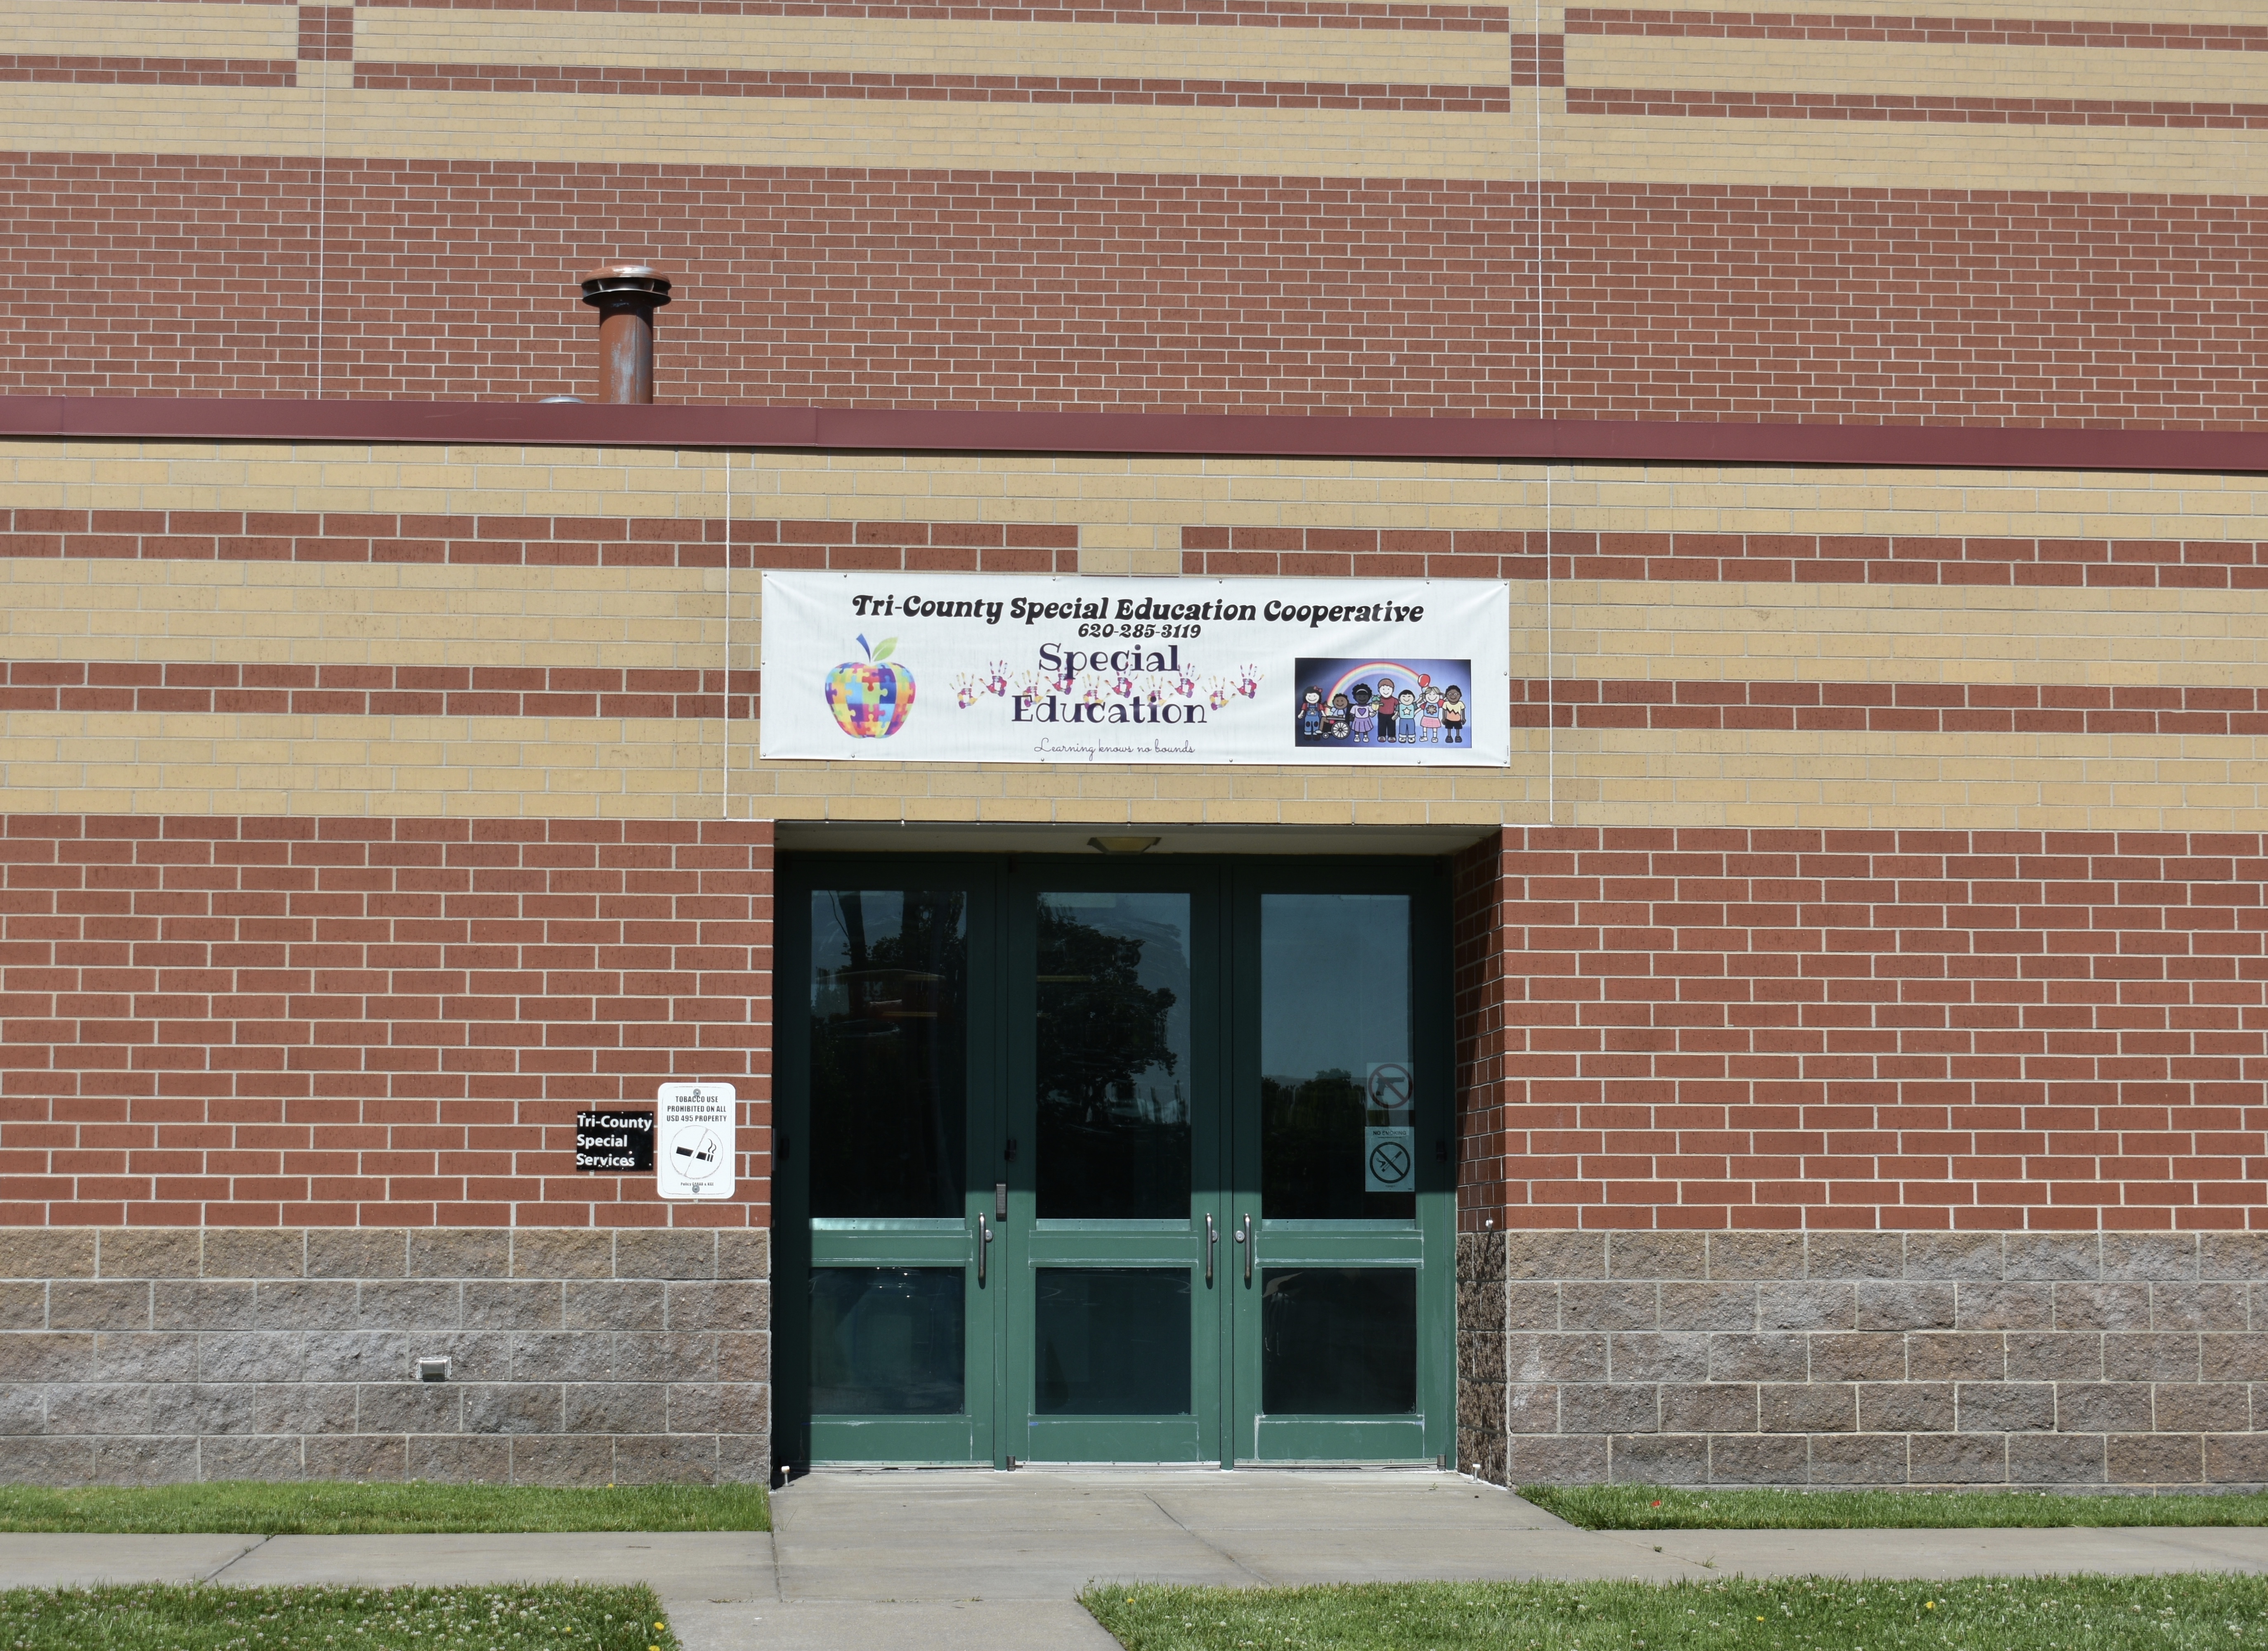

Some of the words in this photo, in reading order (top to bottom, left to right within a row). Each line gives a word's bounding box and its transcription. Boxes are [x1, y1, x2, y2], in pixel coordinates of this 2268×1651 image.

[852, 594, 1003, 624] Tri-County
[1010, 597, 1109, 625] Special
[1115, 597, 1256, 621] Education
[1263, 600, 1424, 628] Cooperative
[1078, 623, 1201, 639] 620-285-3119
[1038, 643, 1180, 680] Special
[1011, 695, 1207, 724] Education
[1034, 737, 1096, 762] Learning
[1098, 739, 1134, 753] knows
[1153, 738, 1195, 754] bounds
[577, 1115, 652, 1131] Tri-County
[577, 1134, 627, 1149] Special
[576, 1153, 635, 1167] Services
